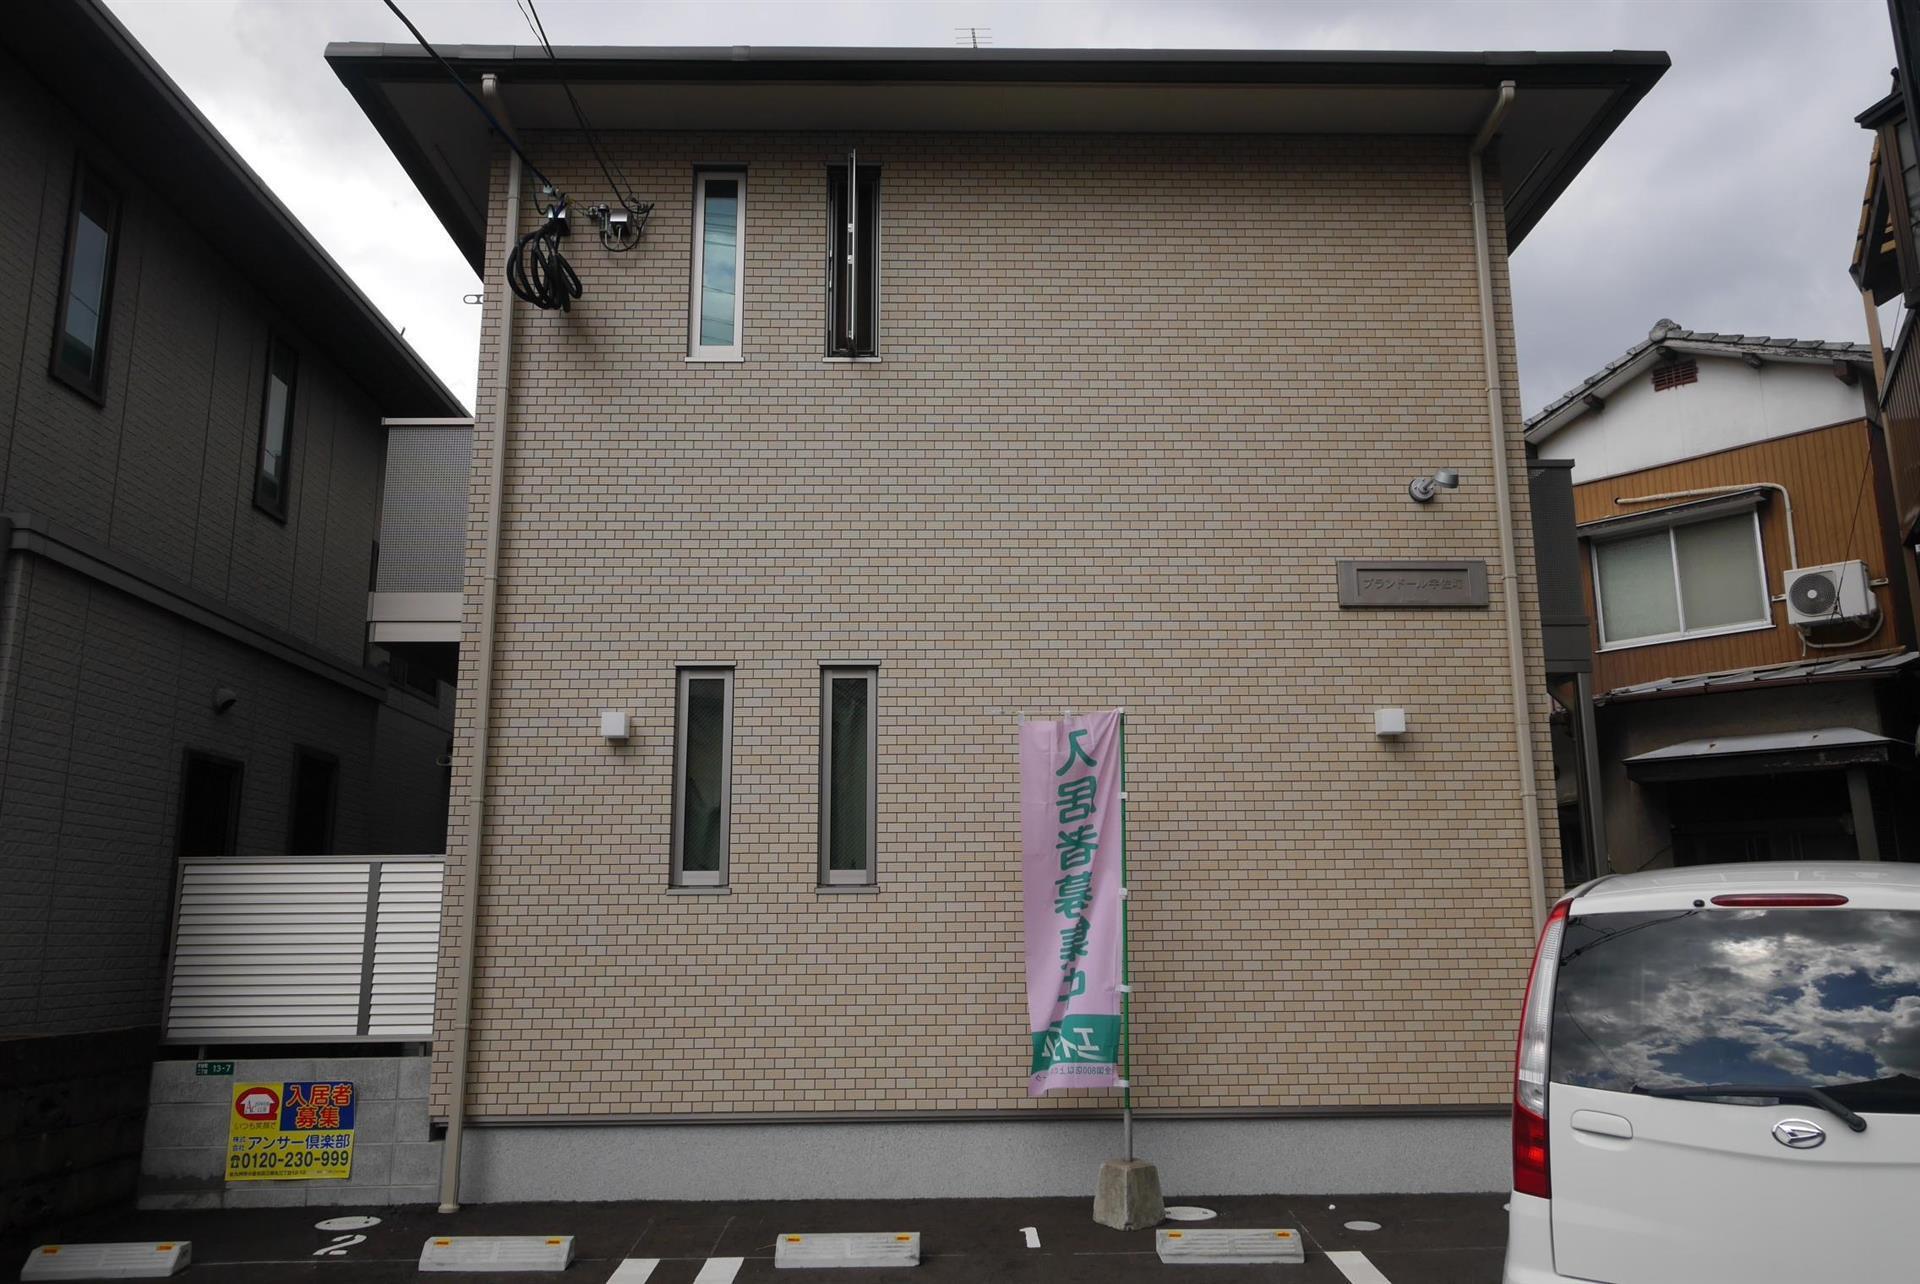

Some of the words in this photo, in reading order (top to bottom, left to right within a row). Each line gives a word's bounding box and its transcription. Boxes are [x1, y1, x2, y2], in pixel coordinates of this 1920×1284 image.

[287, 1084, 352, 1107] 入居者
[295, 1106, 340, 1129] 募集
[248, 1134, 350, 1150] アンサー倶楽部
[242, 1150, 349, 1168] 0120-230-999
[313, 1234, 367, 1255] 2
[1019, 1227, 1041, 1248] 1
